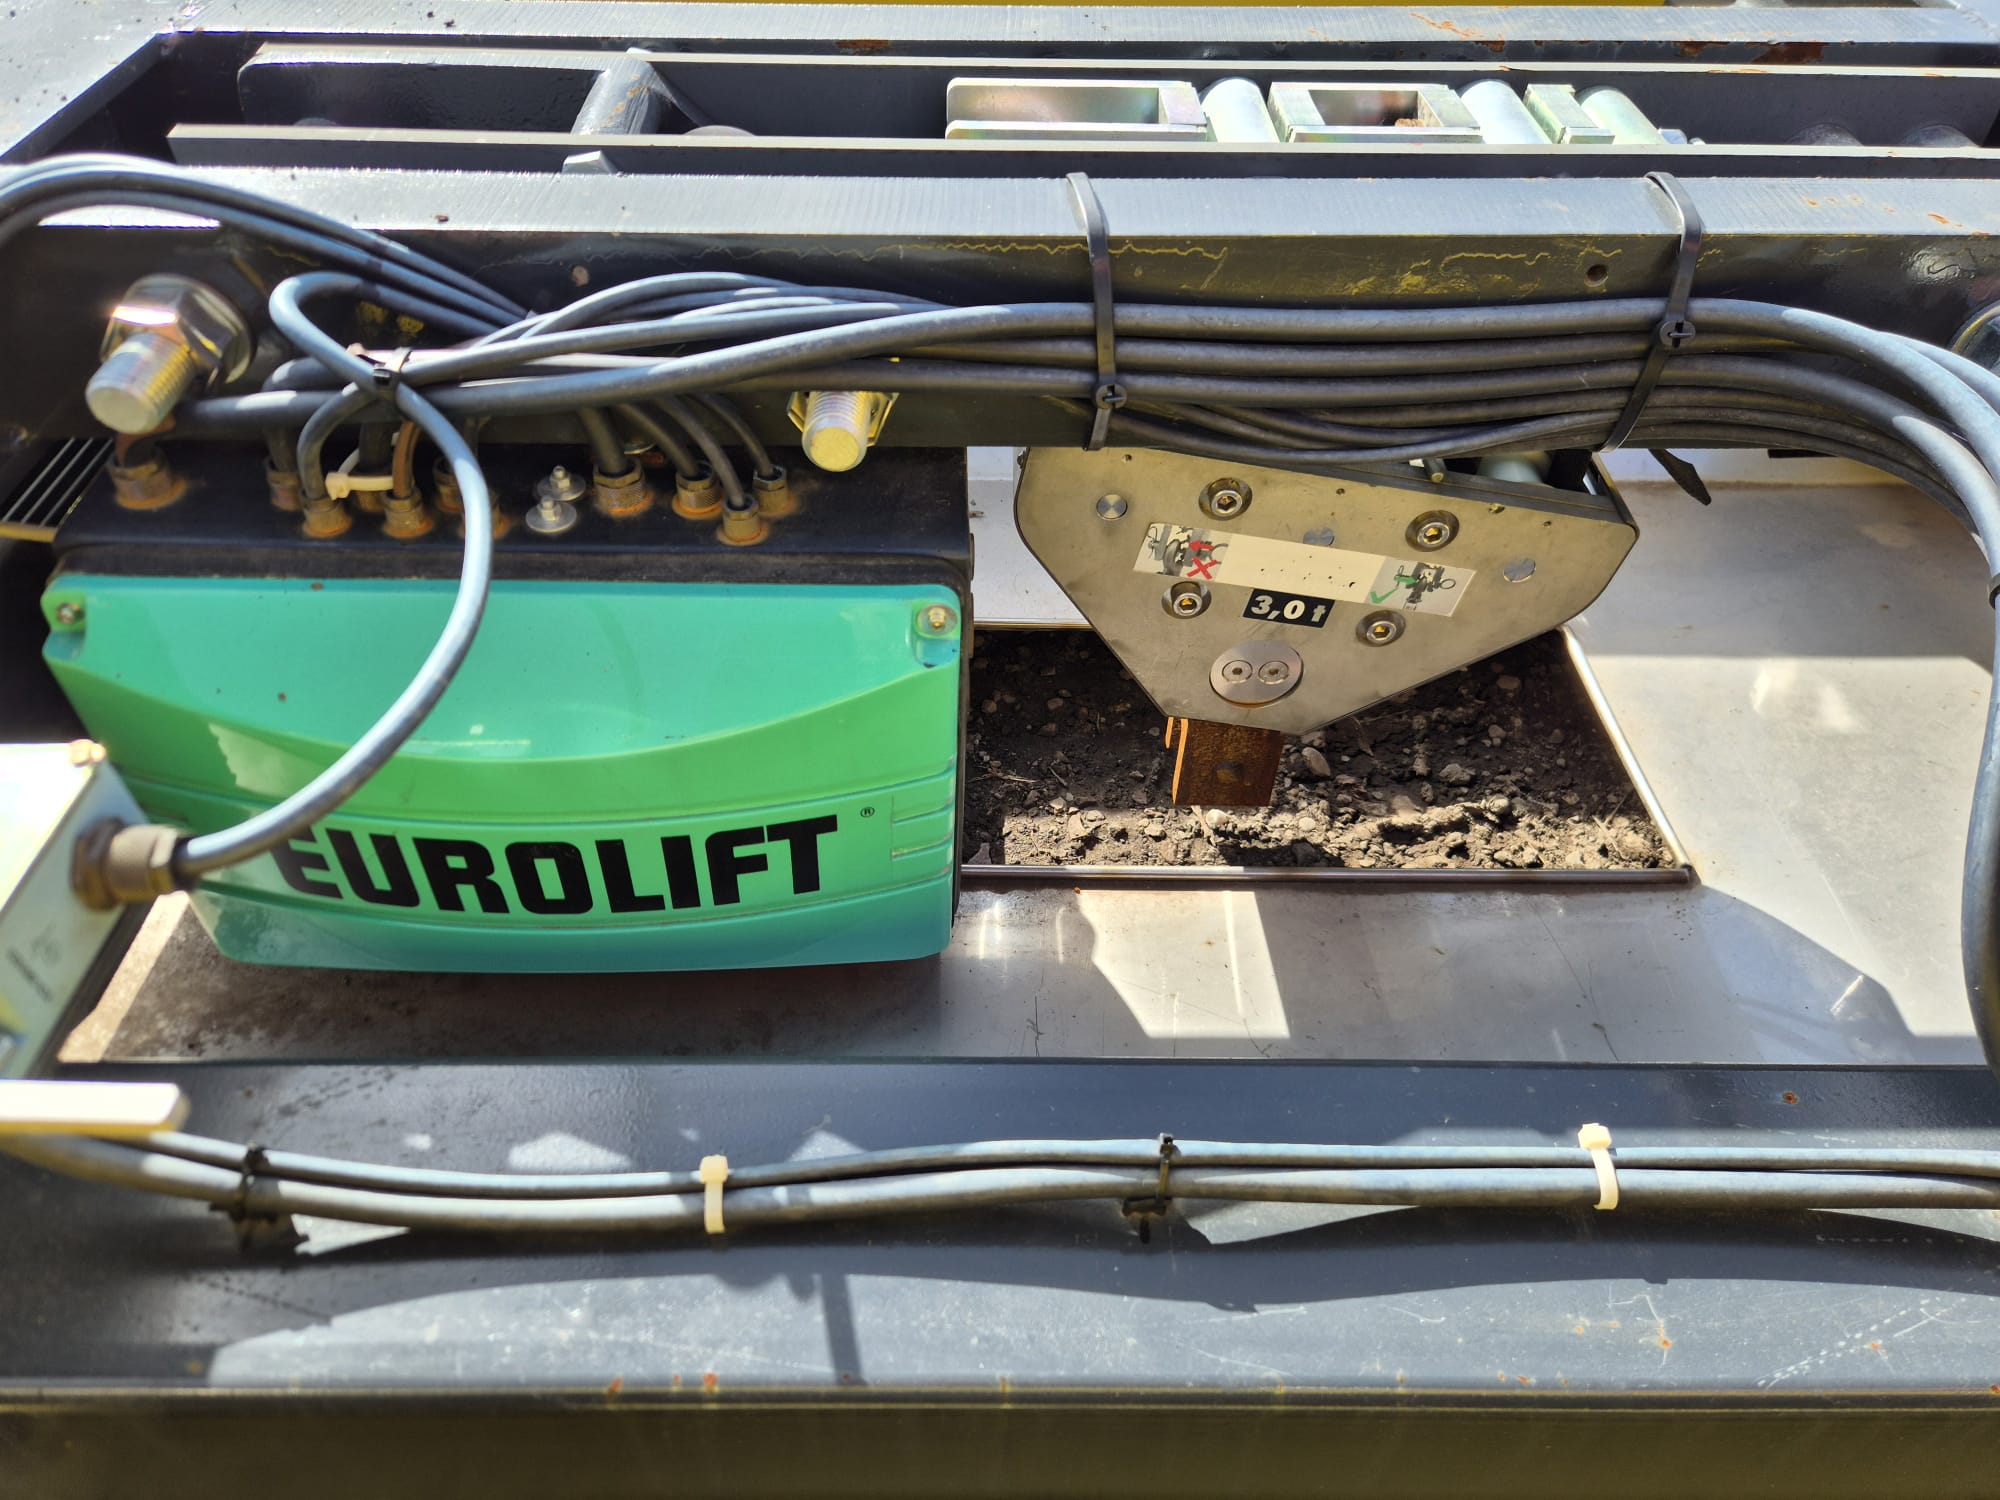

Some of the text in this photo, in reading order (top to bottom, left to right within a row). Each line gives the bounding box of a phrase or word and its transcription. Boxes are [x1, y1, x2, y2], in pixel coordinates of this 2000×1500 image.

[1251, 595, 1326, 622] 3,0 t
[270, 814, 838, 914] EUROLIFT
